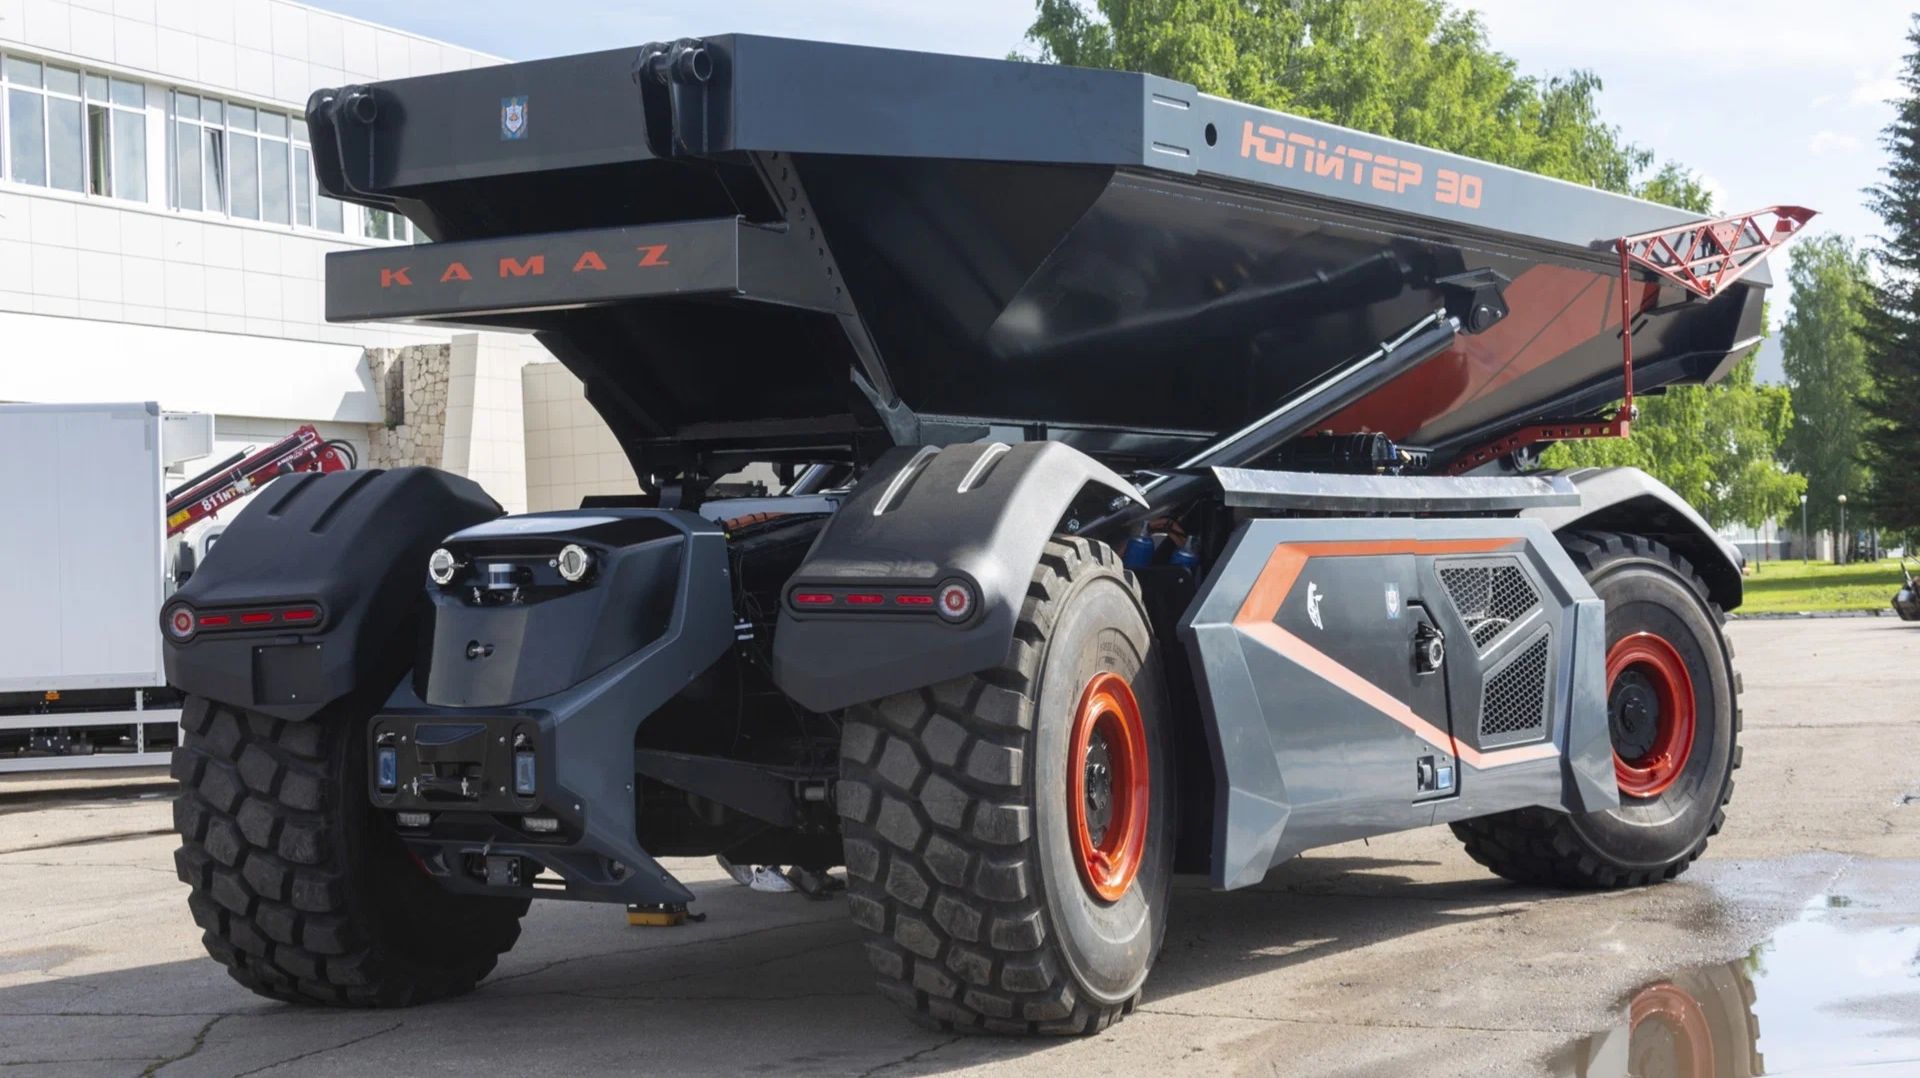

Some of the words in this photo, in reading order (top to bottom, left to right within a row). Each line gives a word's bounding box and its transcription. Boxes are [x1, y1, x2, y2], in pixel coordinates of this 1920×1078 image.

[1240, 120, 1423, 193] ЮПИТЕР
[1435, 168, 1483, 209] 30
[380, 244, 670, 287] KAMAZ
